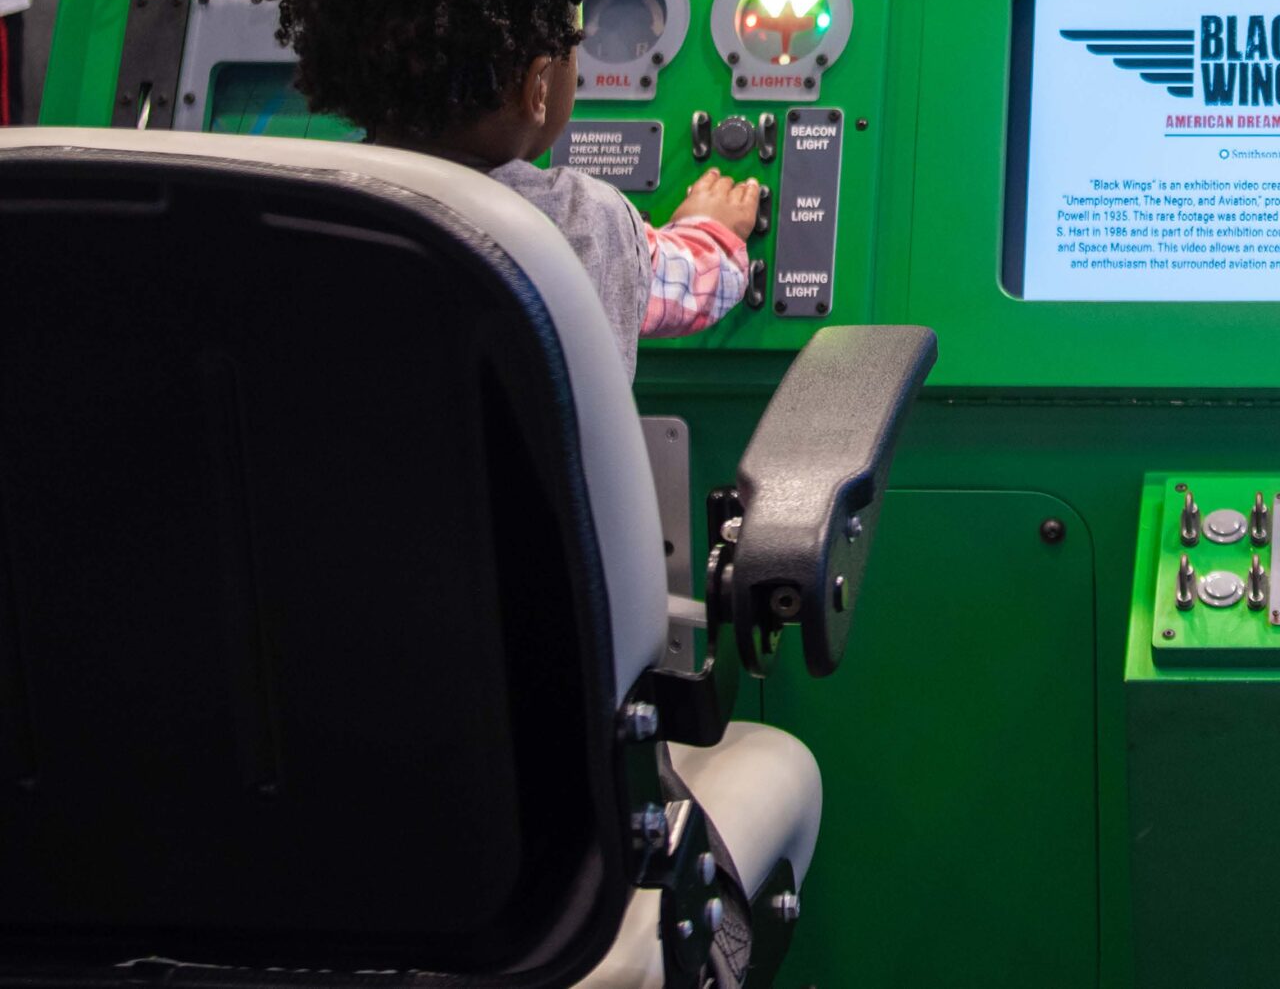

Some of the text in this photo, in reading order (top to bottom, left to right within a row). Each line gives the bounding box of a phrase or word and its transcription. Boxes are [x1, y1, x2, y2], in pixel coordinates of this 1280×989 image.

[595, 75, 631, 88] ROLL
[751, 76, 802, 88] LIGHTS
[1165, 114, 1234, 129] AMERICAN
[791, 126, 836, 137] BEACON
[570, 133, 622, 144] WARNING
[569, 144, 641, 154] CHECK FUEL FOR
[796, 139, 829, 150] LIGHT
[568, 155, 639, 164] CONTAMINANTS
[602, 166, 634, 175] FLIGHT
[1158, 180, 1167, 190] is
[1169, 182, 1181, 190] an
[1184, 180, 1230, 191] exhibition
[1233, 180, 1259, 191] video
[796, 197, 821, 208] NAV
[1143, 195, 1161, 206] The
[1164, 195, 1195, 208] Negro,
[1198, 195, 1216, 206] and
[791, 211, 825, 222] LIGHT
[1058, 210, 1090, 221] Powell
[1092, 211, 1100, 221] in
[1103, 210, 1131, 221] 1935.
[1133, 210, 1153, 221] This
[1156, 213, 1175, 222] rare
[1177, 210, 1215, 224] footage
[1217, 213, 1237, 222] was
[1239, 211, 1278, 222] donated
[1056, 226, 1066, 237] S.
[1068, 226, 1090, 237] Hart
[1092, 227, 1100, 237] in
[1104, 226, 1127, 237] 1986
[1130, 226, 1148, 237] and
[1151, 227, 1159, 237] is
[1162, 227, 1181, 239] part
[1184, 226, 1194, 237] of
[1196, 226, 1214, 237] this
[1216, 226, 1263, 237] exhibition
[1057, 242, 1076, 252] and
[1078, 242, 1108, 254] Space
[1111, 242, 1155, 253] Museum.
[1158, 242, 1178, 253] This
[1181, 242, 1207, 253] video
[1209, 242, 1240, 253] allows
[1243, 244, 1255, 253] an
[1070, 258, 1088, 269] and
[1091, 258, 1146, 269] enthusiasm
[1150, 258, 1169, 269] that
[1171, 258, 1226, 269] surrounded
[1228, 259, 1267, 269] aviation
[778, 273, 828, 284] LANDING
[785, 286, 820, 297] LIGHT
